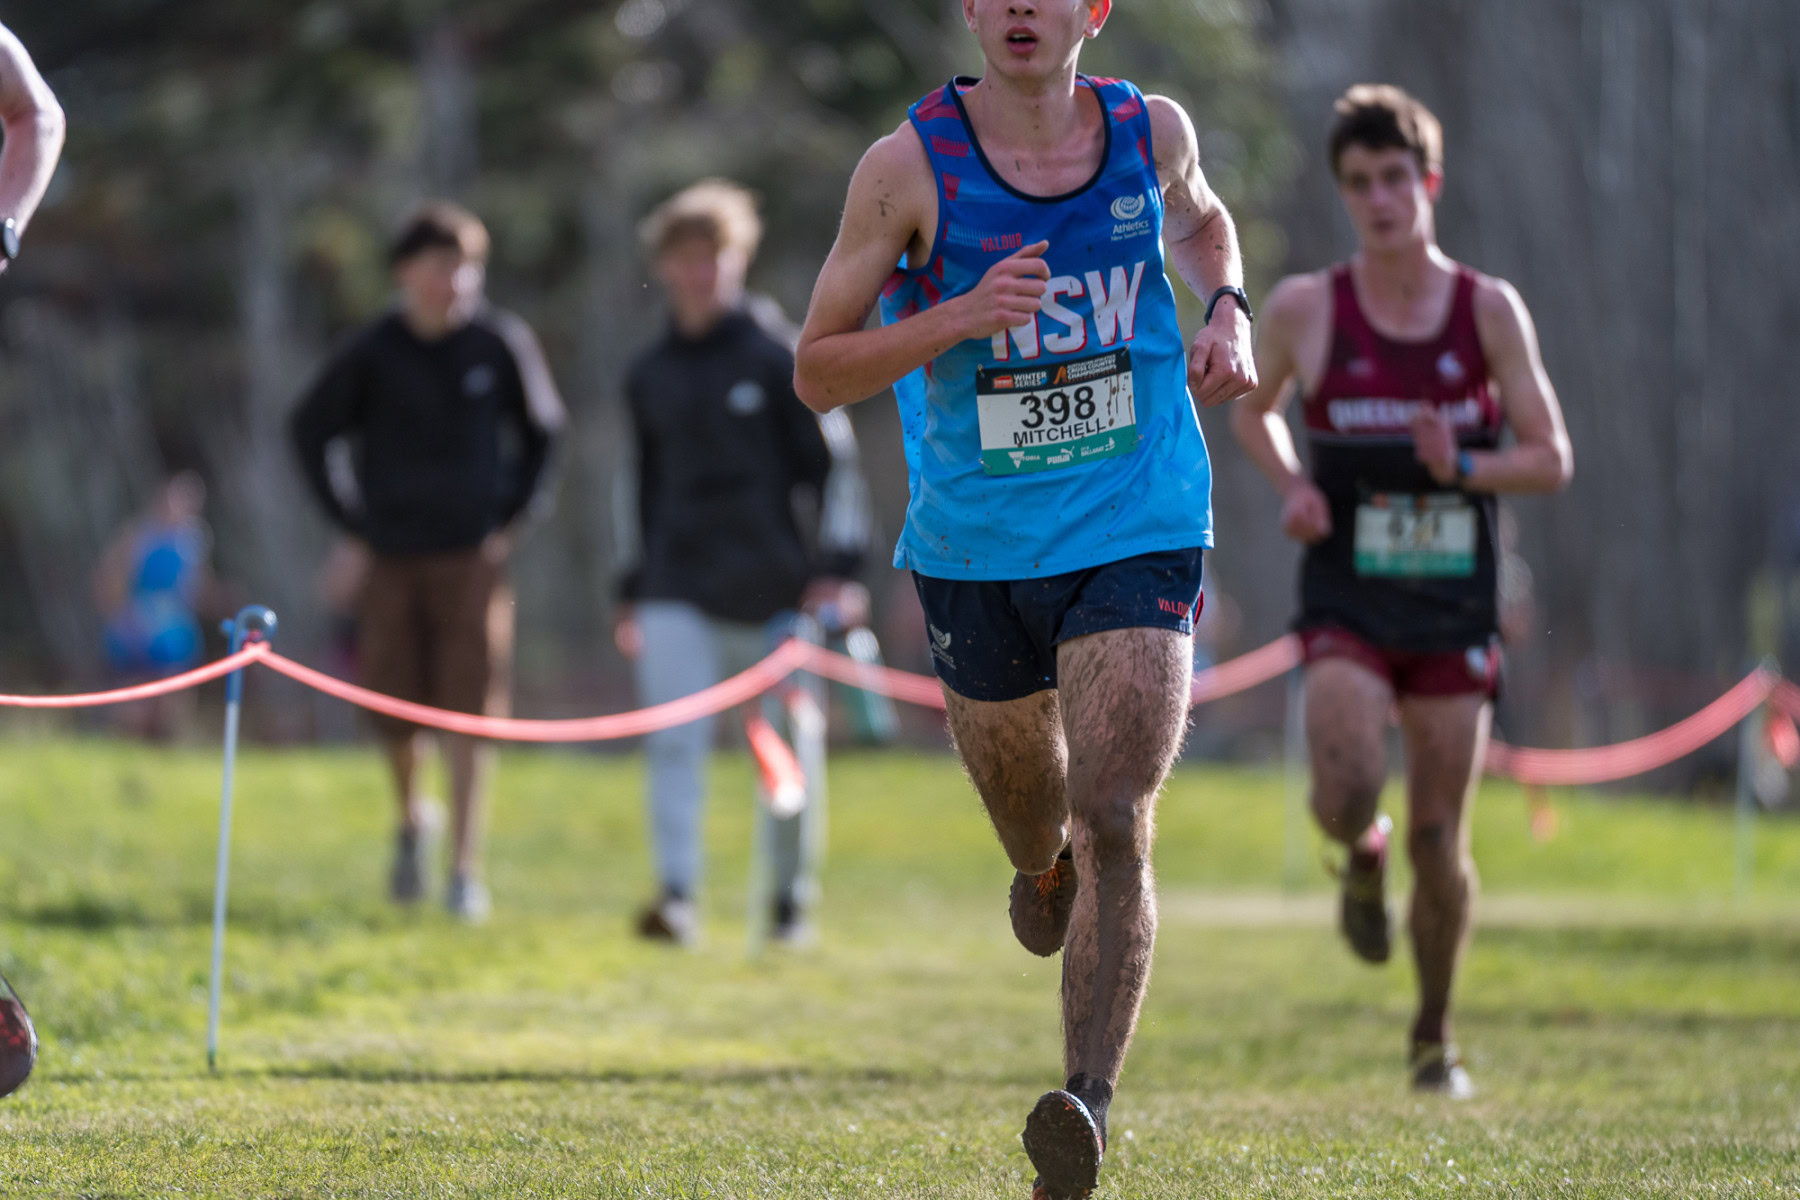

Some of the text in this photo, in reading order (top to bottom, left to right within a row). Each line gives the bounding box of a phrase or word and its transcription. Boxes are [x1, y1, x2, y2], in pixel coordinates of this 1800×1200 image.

[1112, 220, 1149, 235] Athletics
[980, 233, 1022, 252] VALOUR
[1013, 371, 1047, 381] WINTER
[1015, 377, 1042, 388] SERIES
[1020, 386, 1096, 429] 398
[1013, 419, 1107, 445] MITCHELL
[1047, 454, 1070, 465] PUMA
